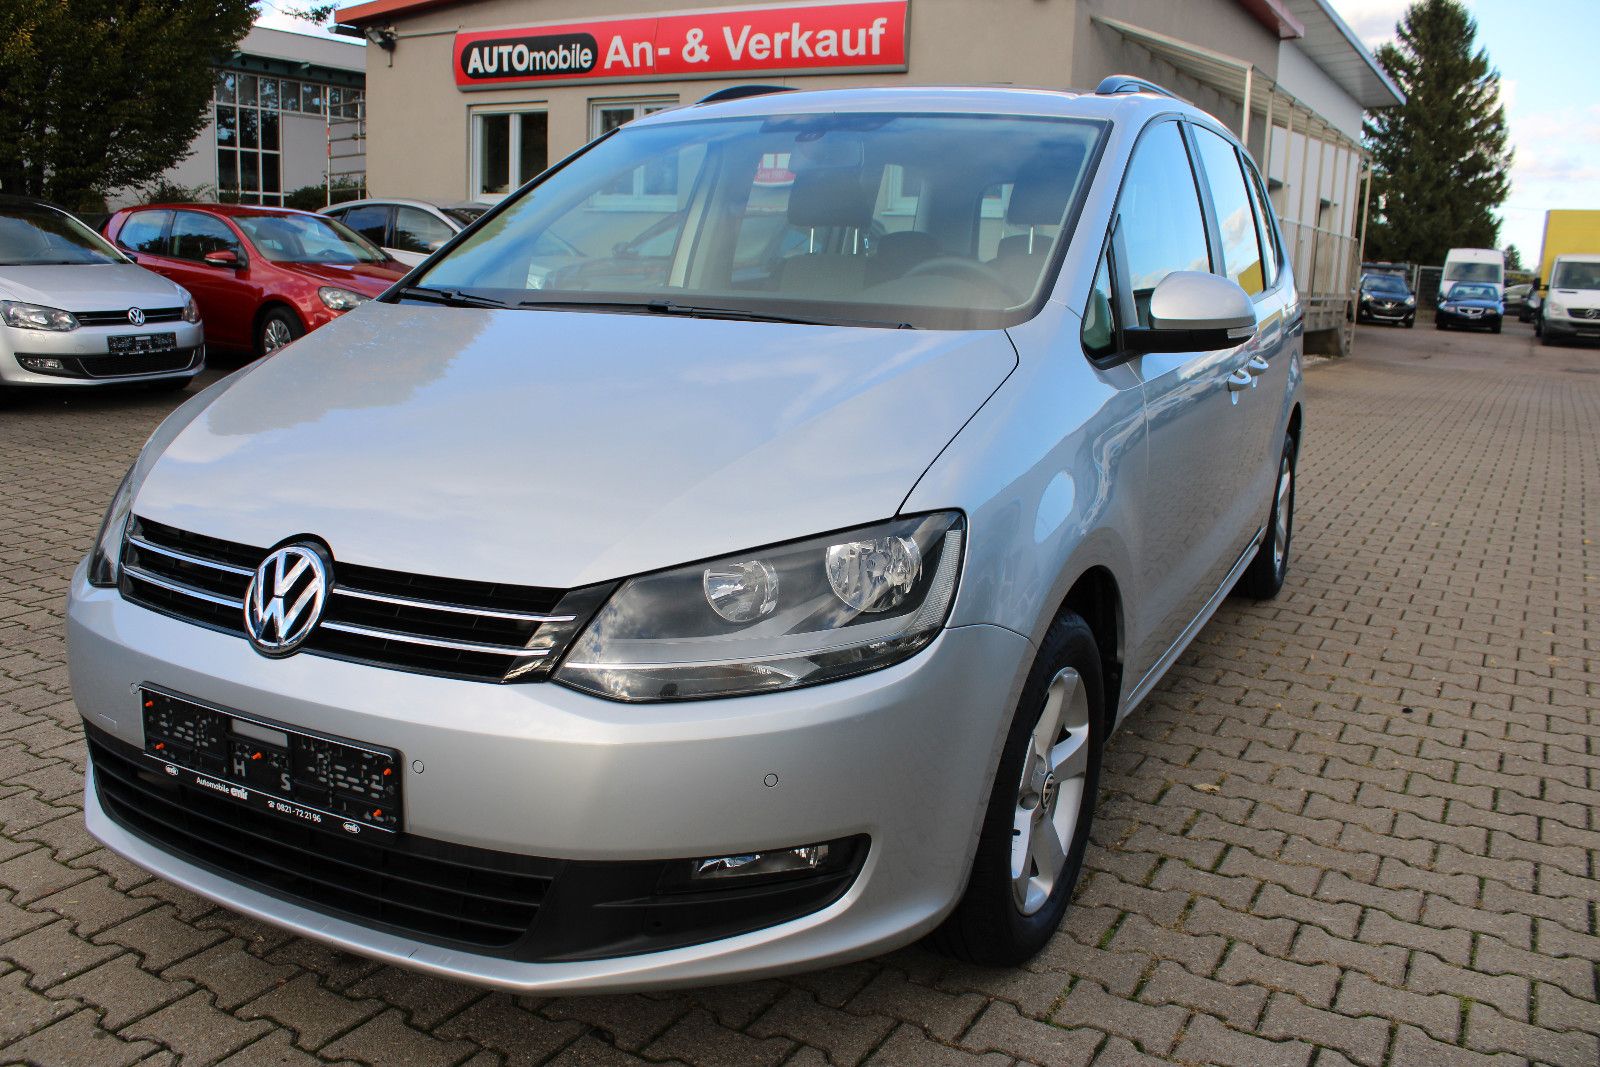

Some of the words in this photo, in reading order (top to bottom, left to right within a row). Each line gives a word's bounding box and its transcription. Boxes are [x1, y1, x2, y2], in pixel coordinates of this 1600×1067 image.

[467, 43, 593, 74] AUTOmobile
[604, 35, 671, 70] An-
[682, 27, 710, 63] &
[722, 17, 888, 61] Verkauf
[196, 776, 230, 795] Automobile
